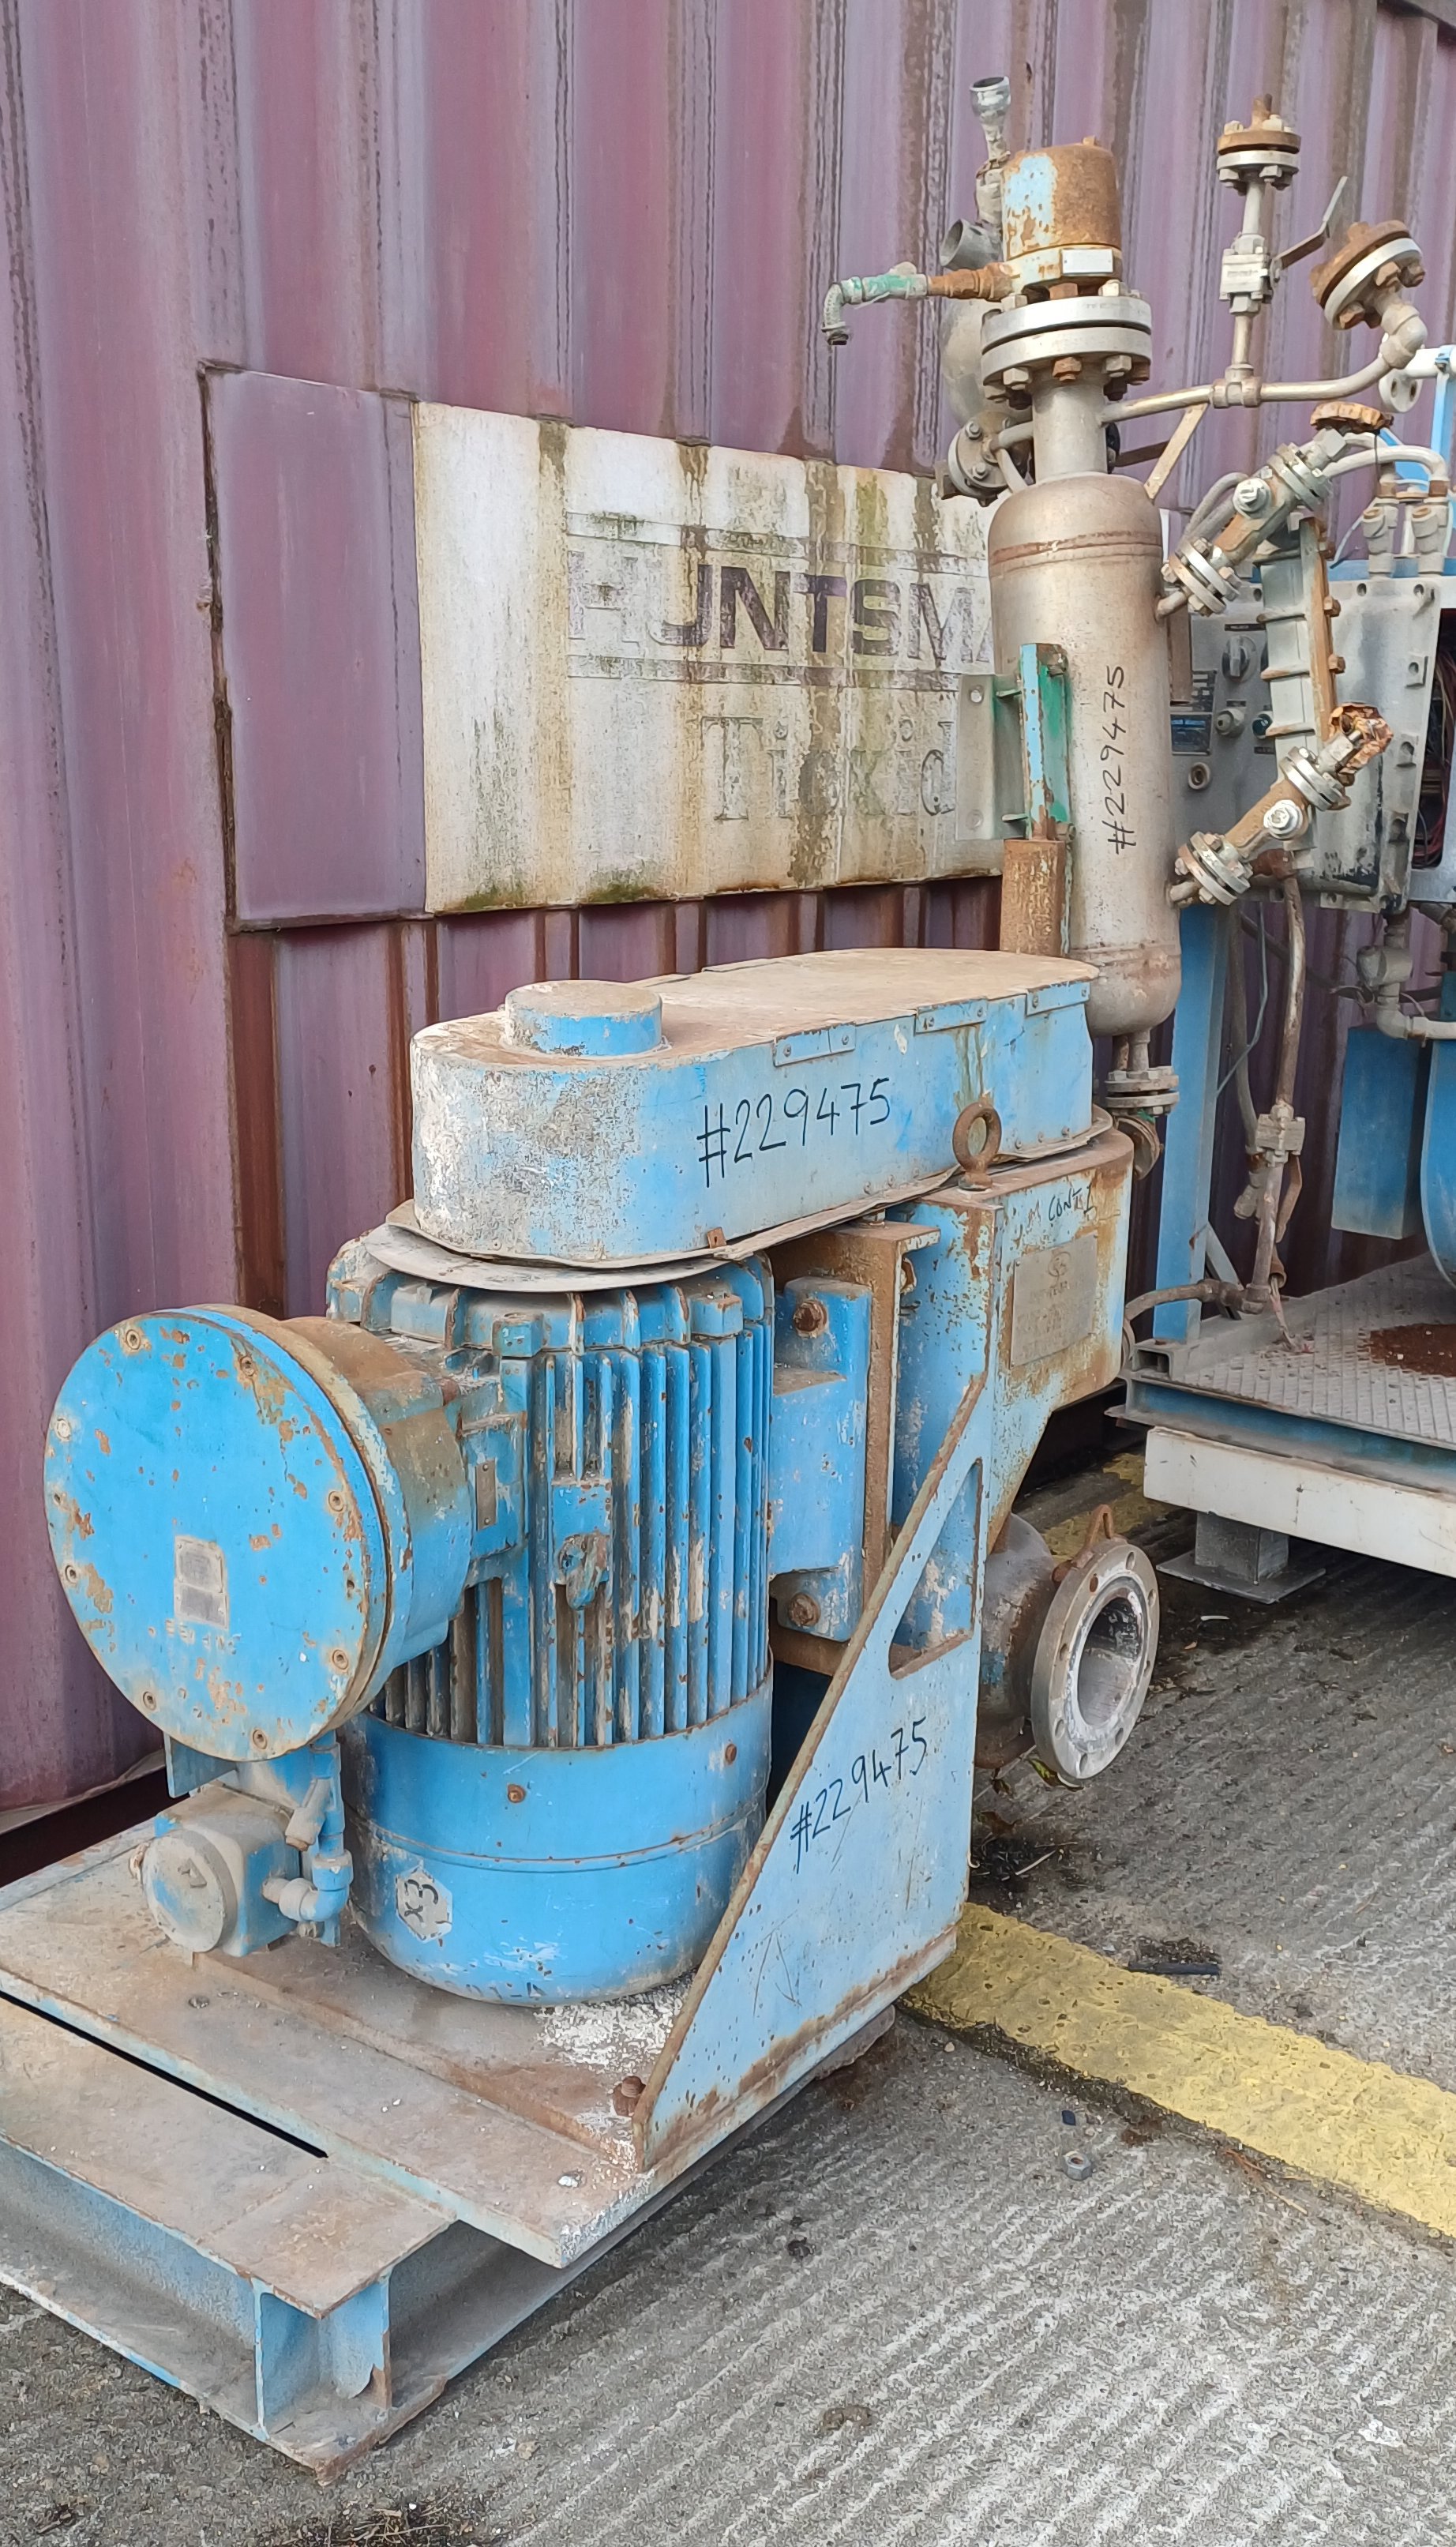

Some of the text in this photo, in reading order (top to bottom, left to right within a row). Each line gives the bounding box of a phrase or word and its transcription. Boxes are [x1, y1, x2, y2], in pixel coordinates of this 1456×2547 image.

[1100, 666, 1136, 855] #229475
[696, 1077, 890, 1188] #229475
[790, 1716, 928, 1875] #229475
